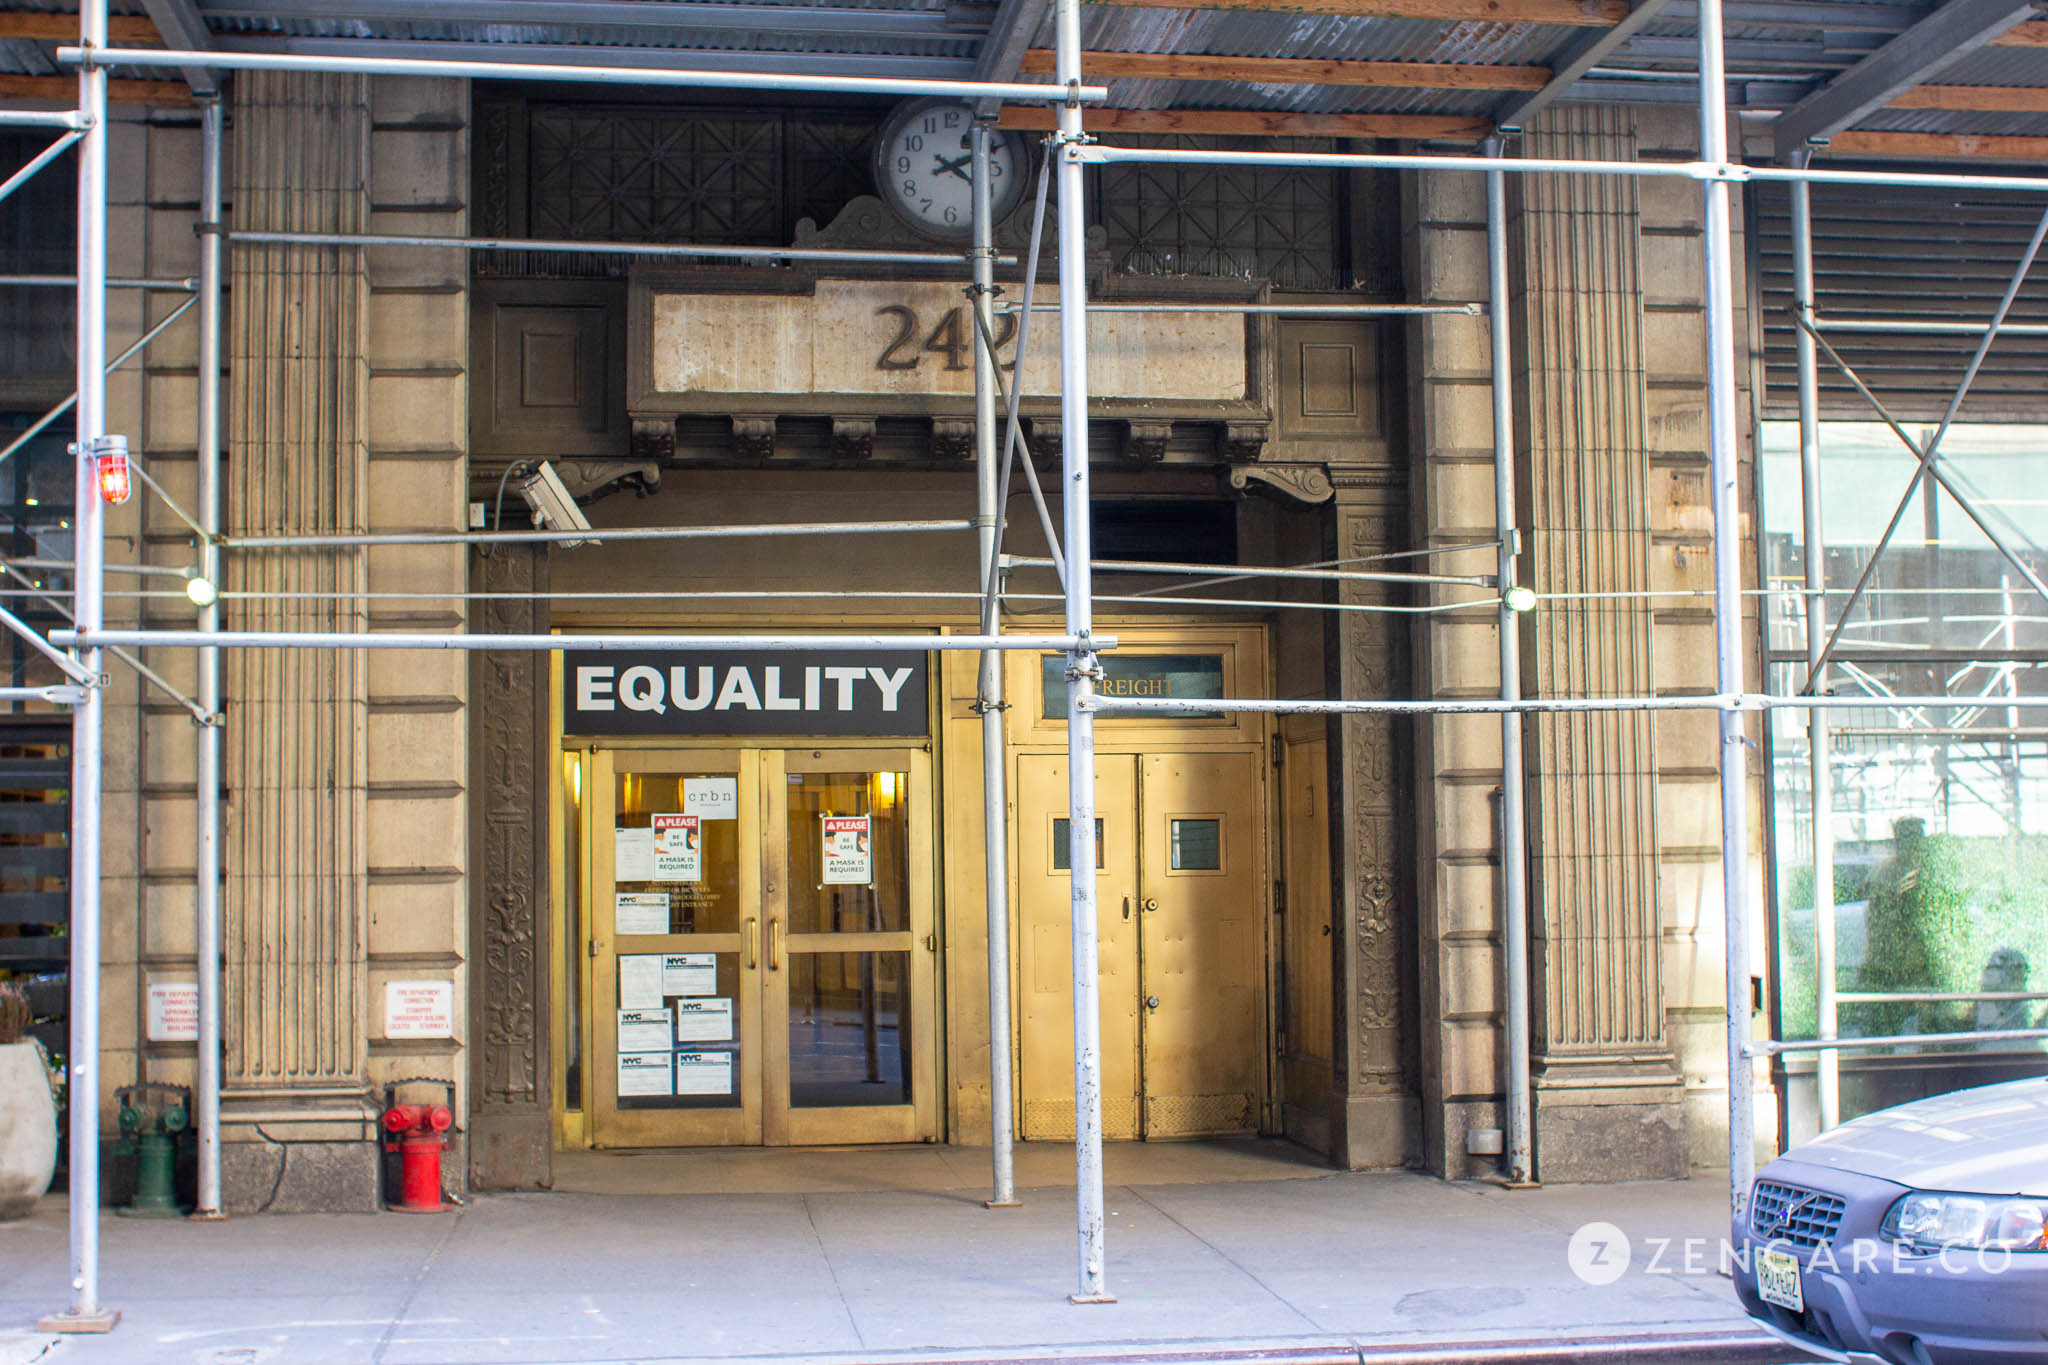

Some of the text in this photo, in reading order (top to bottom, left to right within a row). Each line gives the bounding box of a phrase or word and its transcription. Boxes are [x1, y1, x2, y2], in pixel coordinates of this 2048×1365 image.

[924, 117, 937, 134] 11
[944, 112, 960, 129] 12
[904, 135, 924, 152] 10
[897, 156, 911, 173] 9
[903, 180, 916, 197] 8
[919, 198, 933, 213] 7
[943, 206, 957, 223] 6
[875, 304, 1018, 371] 242
[577, 665, 915, 716] EQUALITY
[1092, 679, 1174, 697] FREIGHT
[688, 791, 731, 802] crbn
[666, 818, 697, 827] PLEASE
[836, 821, 867, 830] PLEASE
[666, 957, 687, 965] NYC
[682, 1003, 702, 1011] NYC
[622, 1013, 642, 1021] NYC
[680, 1054, 702, 1062] NYC
